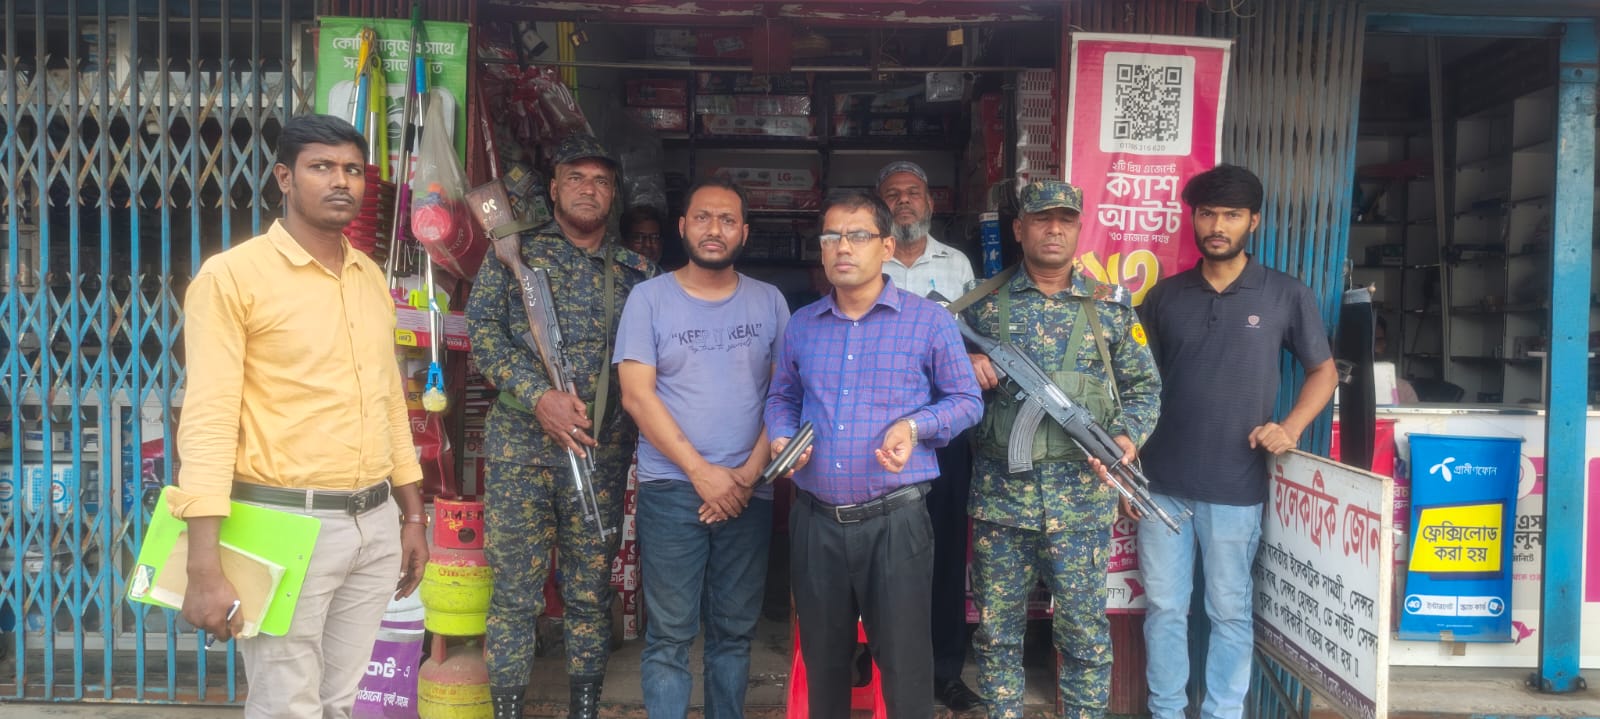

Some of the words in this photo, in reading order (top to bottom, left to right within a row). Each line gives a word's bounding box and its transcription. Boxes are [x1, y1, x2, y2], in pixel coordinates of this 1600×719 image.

[777, 172, 792, 182] LG
[1106, 172, 1179, 201] ক্যাশ
[1098, 200, 1182, 233] আউট
[1274, 462, 1339, 554] ইলেকট্রিক
[1422, 520, 1500, 543] ফ্লেক্সিলোড
[1433, 545, 1463, 561] করা
[1465, 546, 1488, 562] হয়
